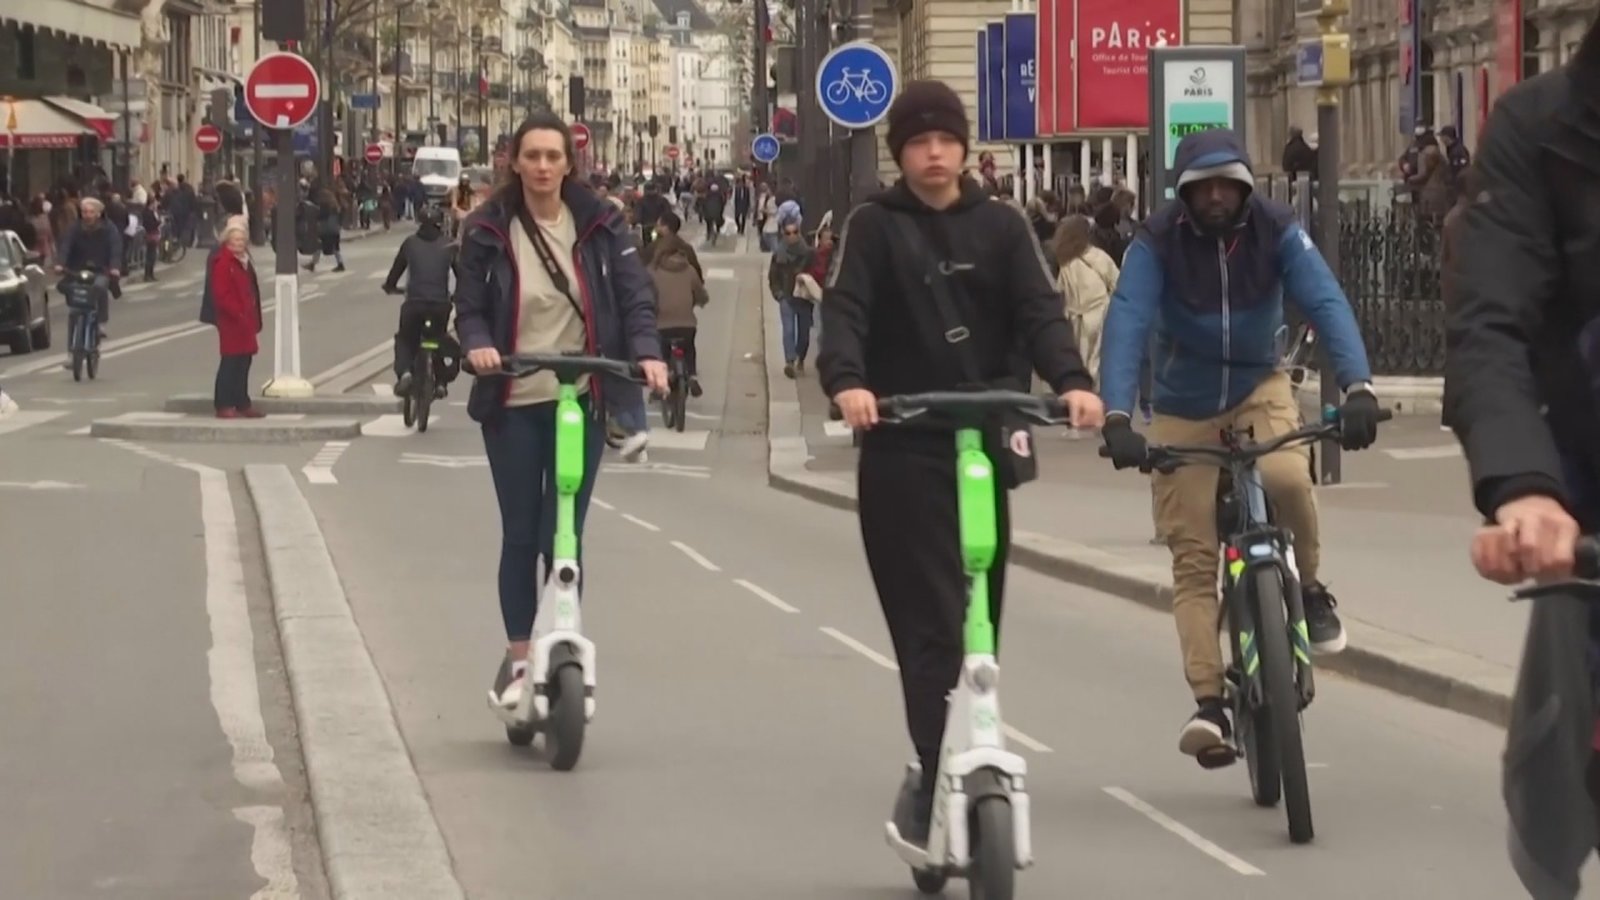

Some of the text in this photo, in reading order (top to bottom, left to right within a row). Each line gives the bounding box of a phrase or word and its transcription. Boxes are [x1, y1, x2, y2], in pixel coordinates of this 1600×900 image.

[1092, 53, 1116, 62] Office
[1118, 53, 1128, 61] de
[1103, 66, 1130, 75] Tourist
[1183, 87, 1213, 96] PARIS
[21, 136, 75, 144] RESTAURANT
